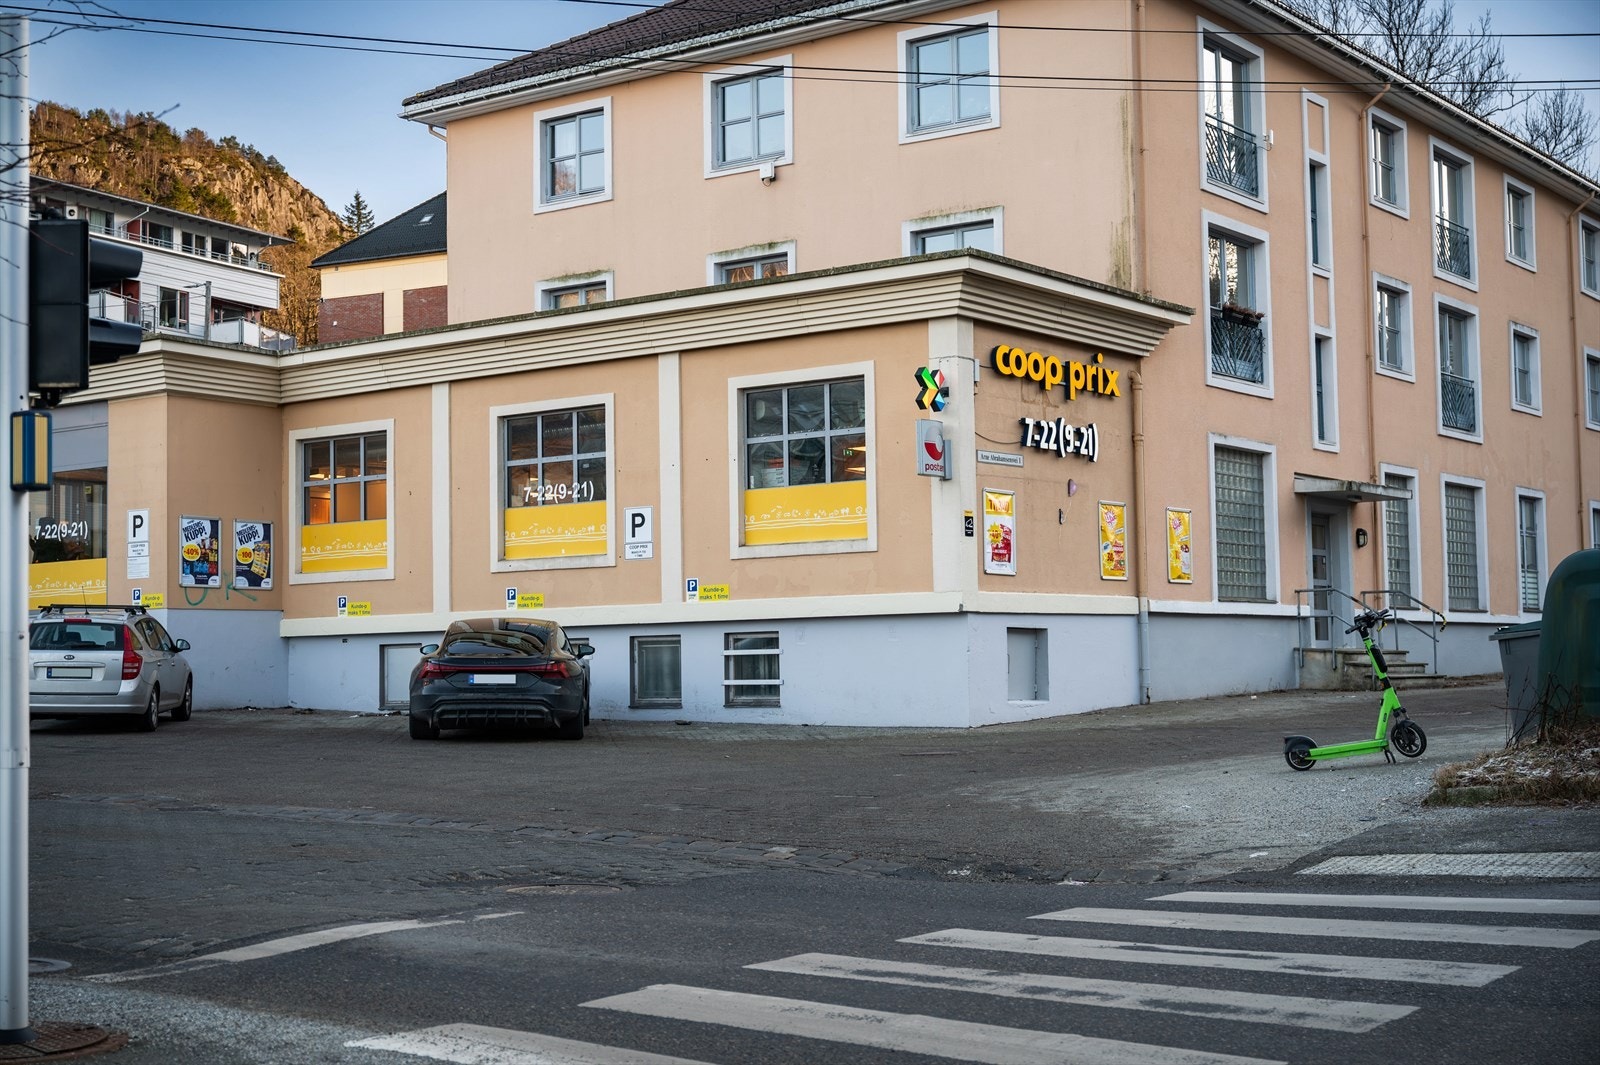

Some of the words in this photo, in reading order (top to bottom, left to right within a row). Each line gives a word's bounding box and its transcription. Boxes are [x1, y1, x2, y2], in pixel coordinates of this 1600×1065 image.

[993, 345, 1063, 391] coop
[1067, 353, 1121, 400] prix
[1023, 417, 1099, 462] 7-22(9-21)
[523, 480, 594, 503] 7-22(9-21)
[35, 520, 88, 541] 7-22(9-21)
[133, 515, 144, 538] P
[184, 526, 207, 542] KUPP!
[632, 513, 645, 538] P
[238, 530, 260, 546] KUPP!
[134, 590, 140, 600] P
[510, 590, 515, 600] P
[690, 581, 695, 591] P
[340, 598, 346, 608] P
